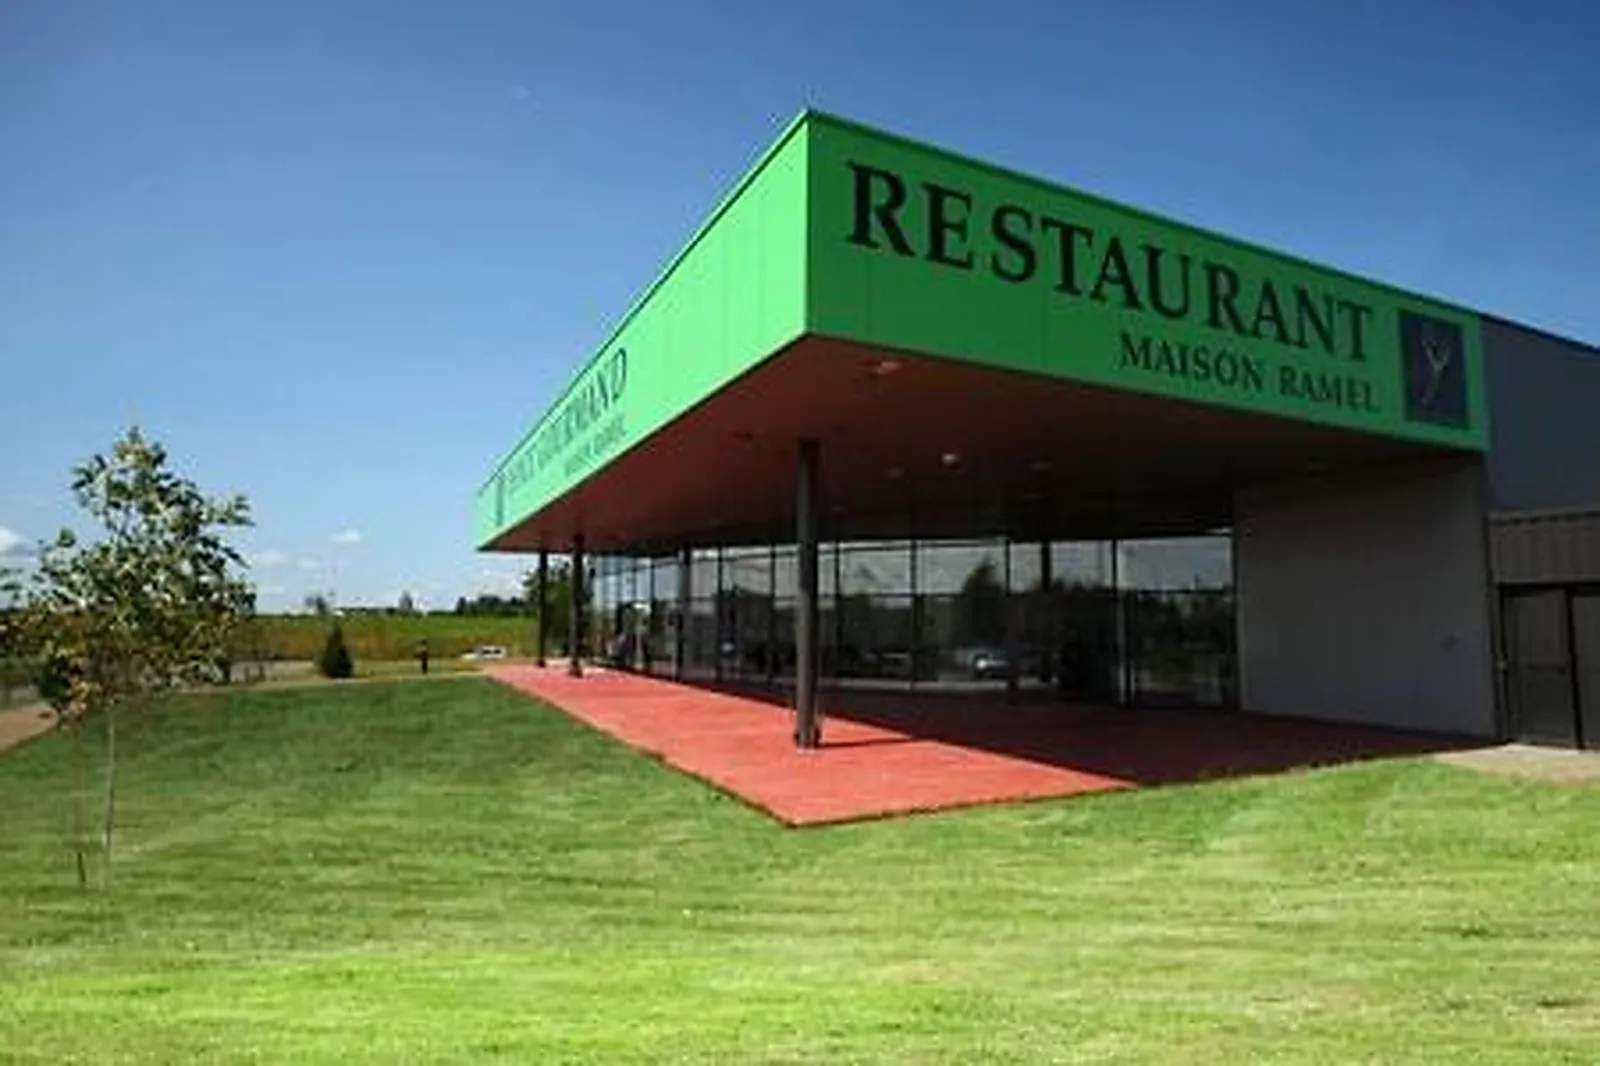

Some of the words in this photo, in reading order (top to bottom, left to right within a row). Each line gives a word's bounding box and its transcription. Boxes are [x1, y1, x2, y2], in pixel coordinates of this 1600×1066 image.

[846, 159, 1371, 361] RESTAURANT
[1119, 331, 1264, 391] MAISON
[1279, 365, 1380, 412] RAMEL
